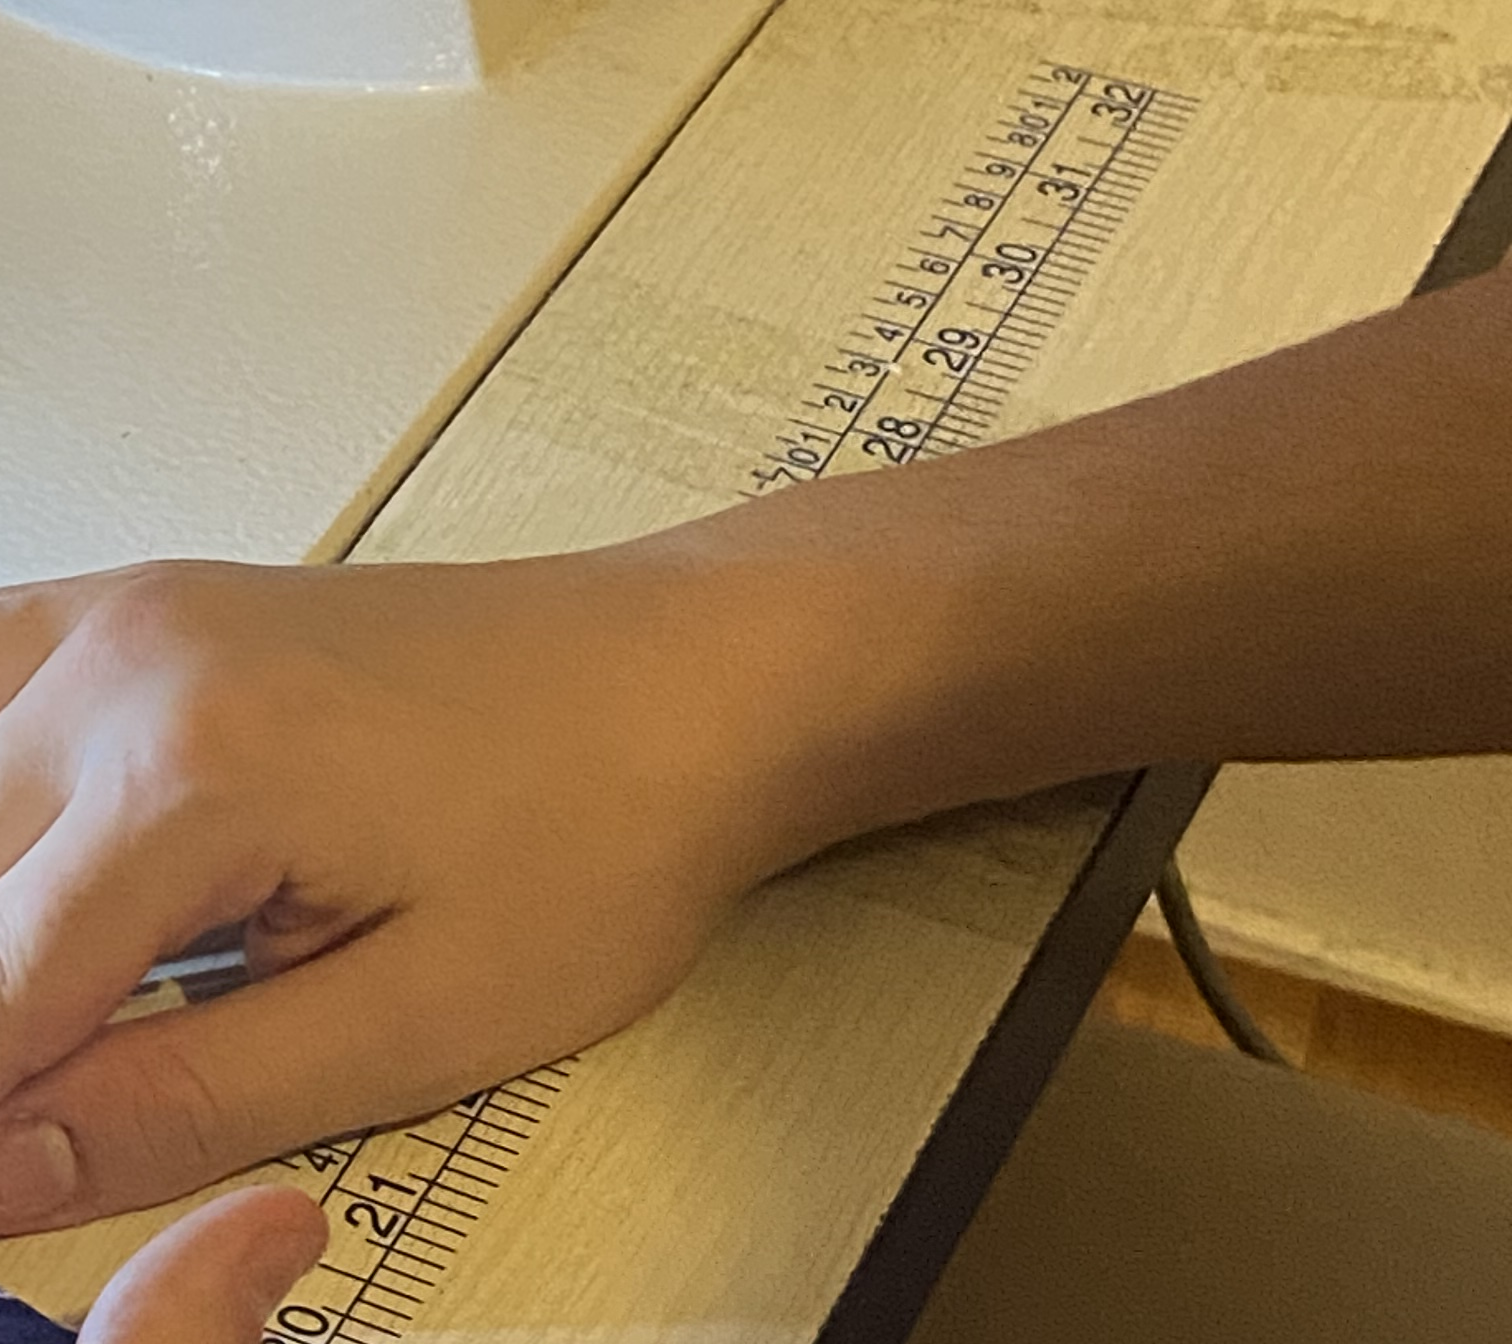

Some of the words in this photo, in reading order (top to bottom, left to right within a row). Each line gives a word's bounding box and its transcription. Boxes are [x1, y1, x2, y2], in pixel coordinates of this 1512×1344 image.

[1052, 67, 1082, 84] 2
[1032, 99, 1060, 111] 1
[1090, 83, 1146, 124] 32
[985, 162, 1017, 179] 9
[1036, 162, 1093, 202] 31
[963, 193, 994, 211] 8
[938, 224, 971, 242] 7
[919, 258, 951, 275] 6
[980, 242, 1039, 285] 30
[895, 290, 928, 309] 5
[874, 325, 905, 342] 4
[922, 327, 981, 373] 29
[847, 360, 881, 378] 3
[824, 394, 858, 413] 2
[800, 431, 832, 444] 1
[861, 416, 922, 464] 28
[304, 1149, 339, 1173] 4
[344, 1174, 417, 1239] 21
